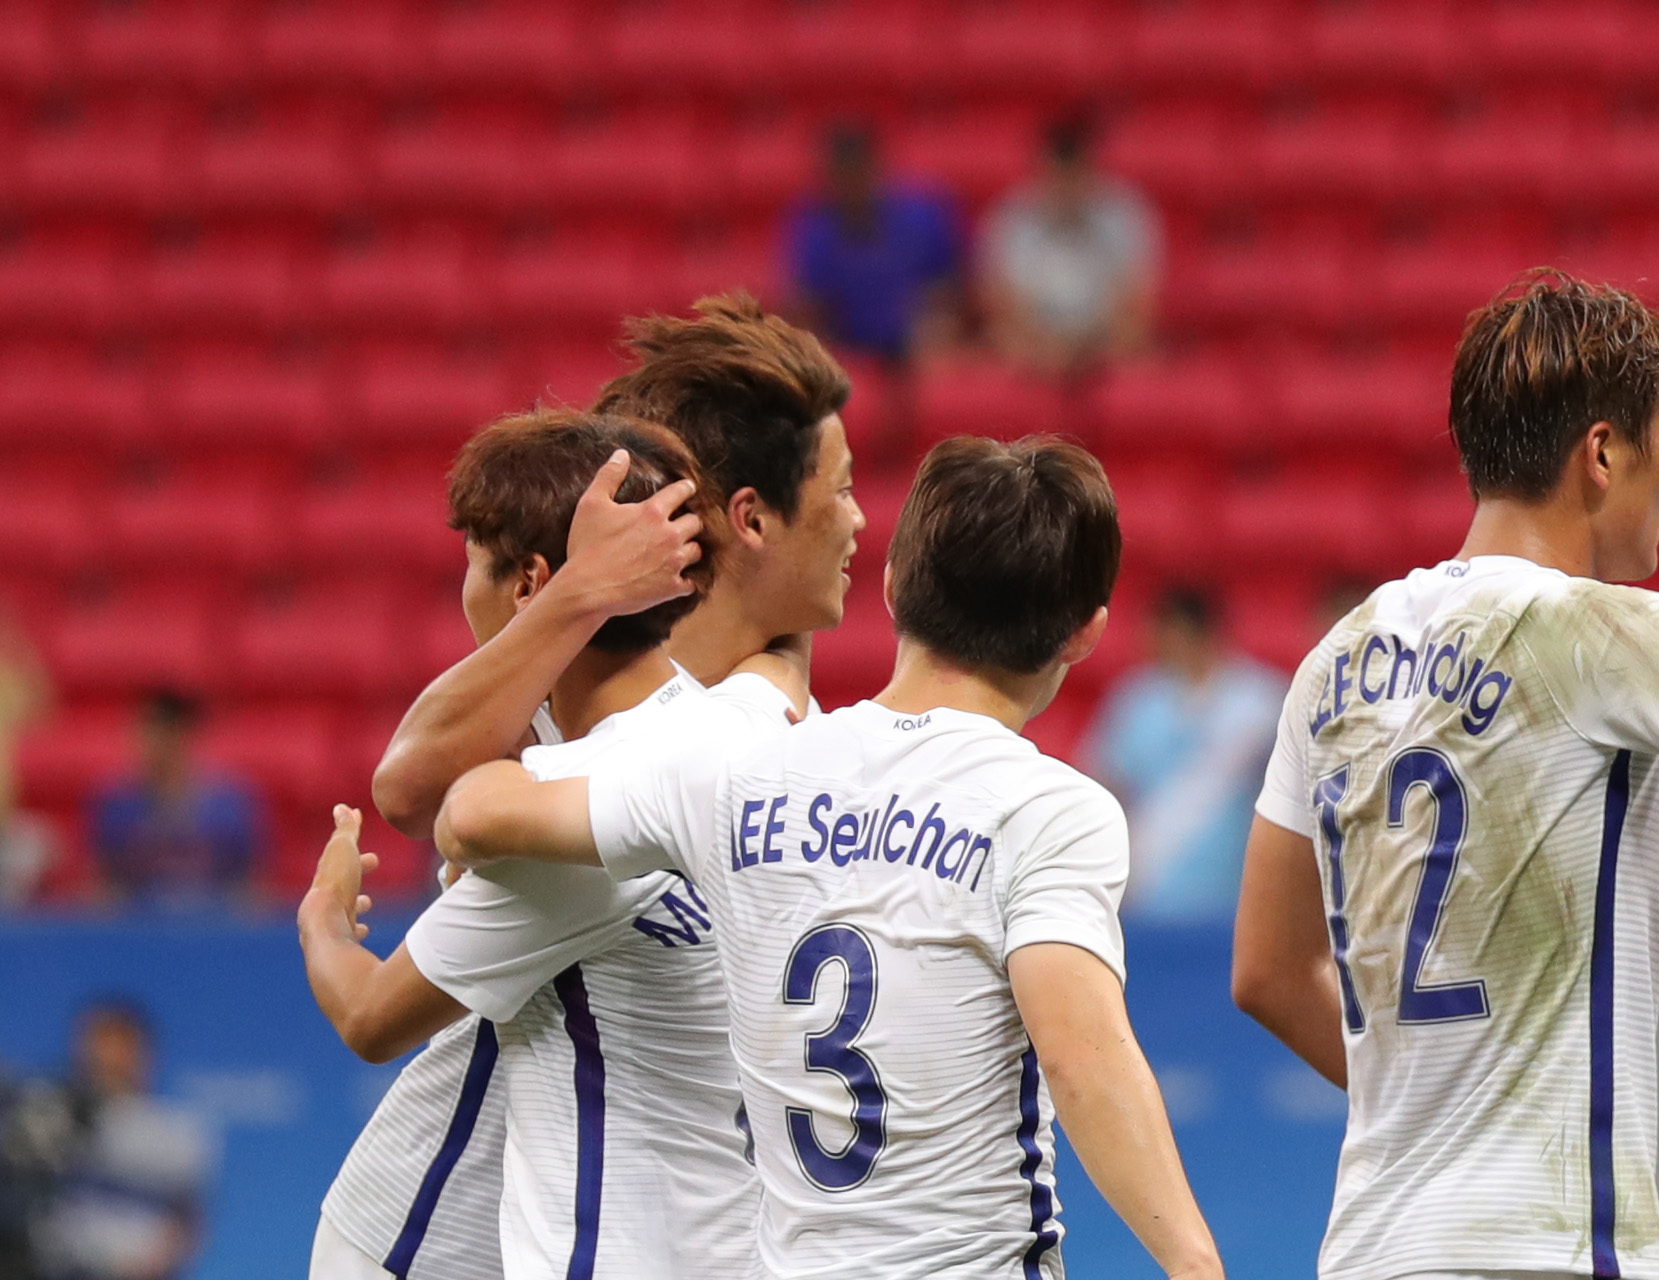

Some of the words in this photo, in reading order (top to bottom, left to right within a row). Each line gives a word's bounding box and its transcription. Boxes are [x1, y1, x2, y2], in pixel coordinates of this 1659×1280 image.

[801, 793, 992, 893] Seulchan
[1314, 746, 1491, 1034] 12
[783, 921, 888, 1193] 3
